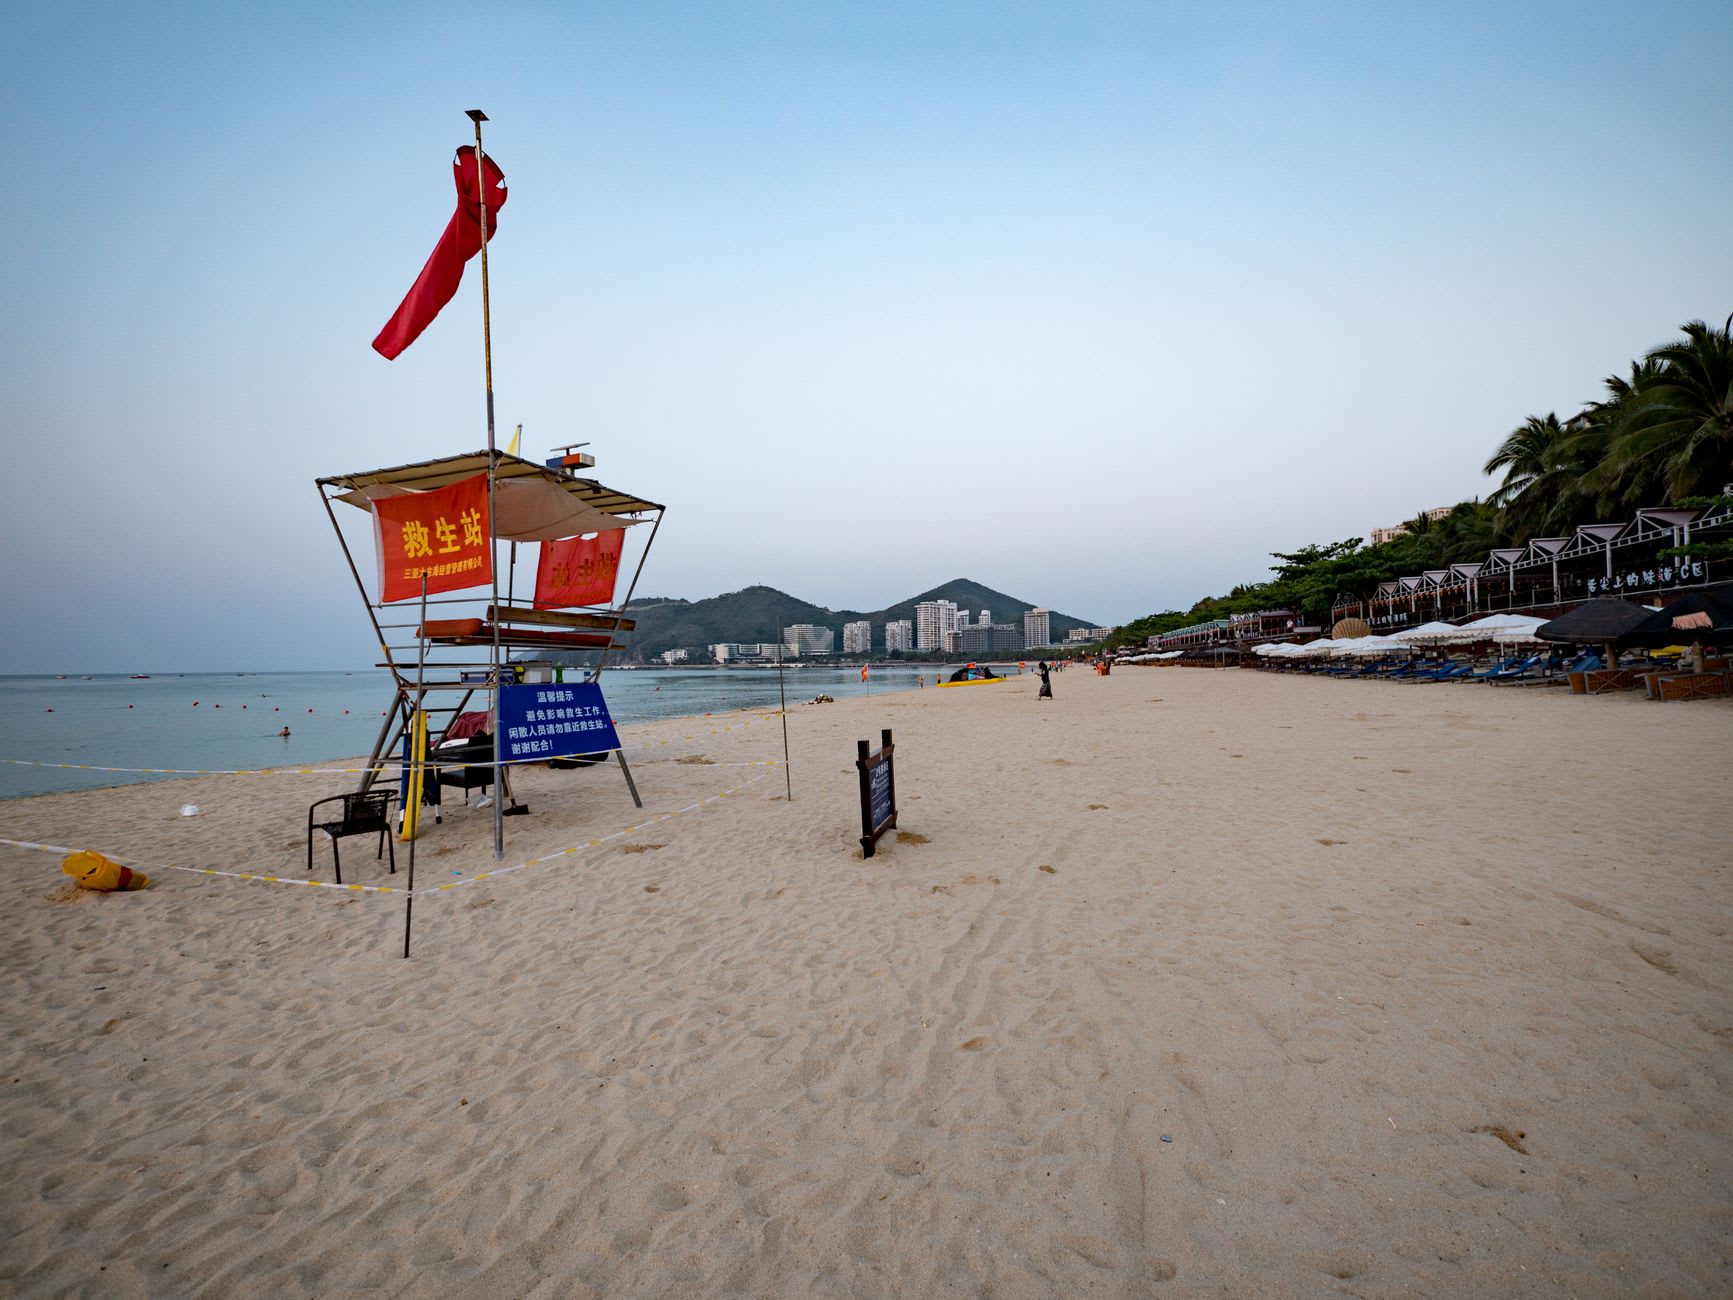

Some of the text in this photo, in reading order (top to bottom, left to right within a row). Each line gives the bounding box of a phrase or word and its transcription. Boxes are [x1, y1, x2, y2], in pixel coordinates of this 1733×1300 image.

[402, 507, 484, 559] 救生站
[537, 690, 574, 703] 温馨提示
